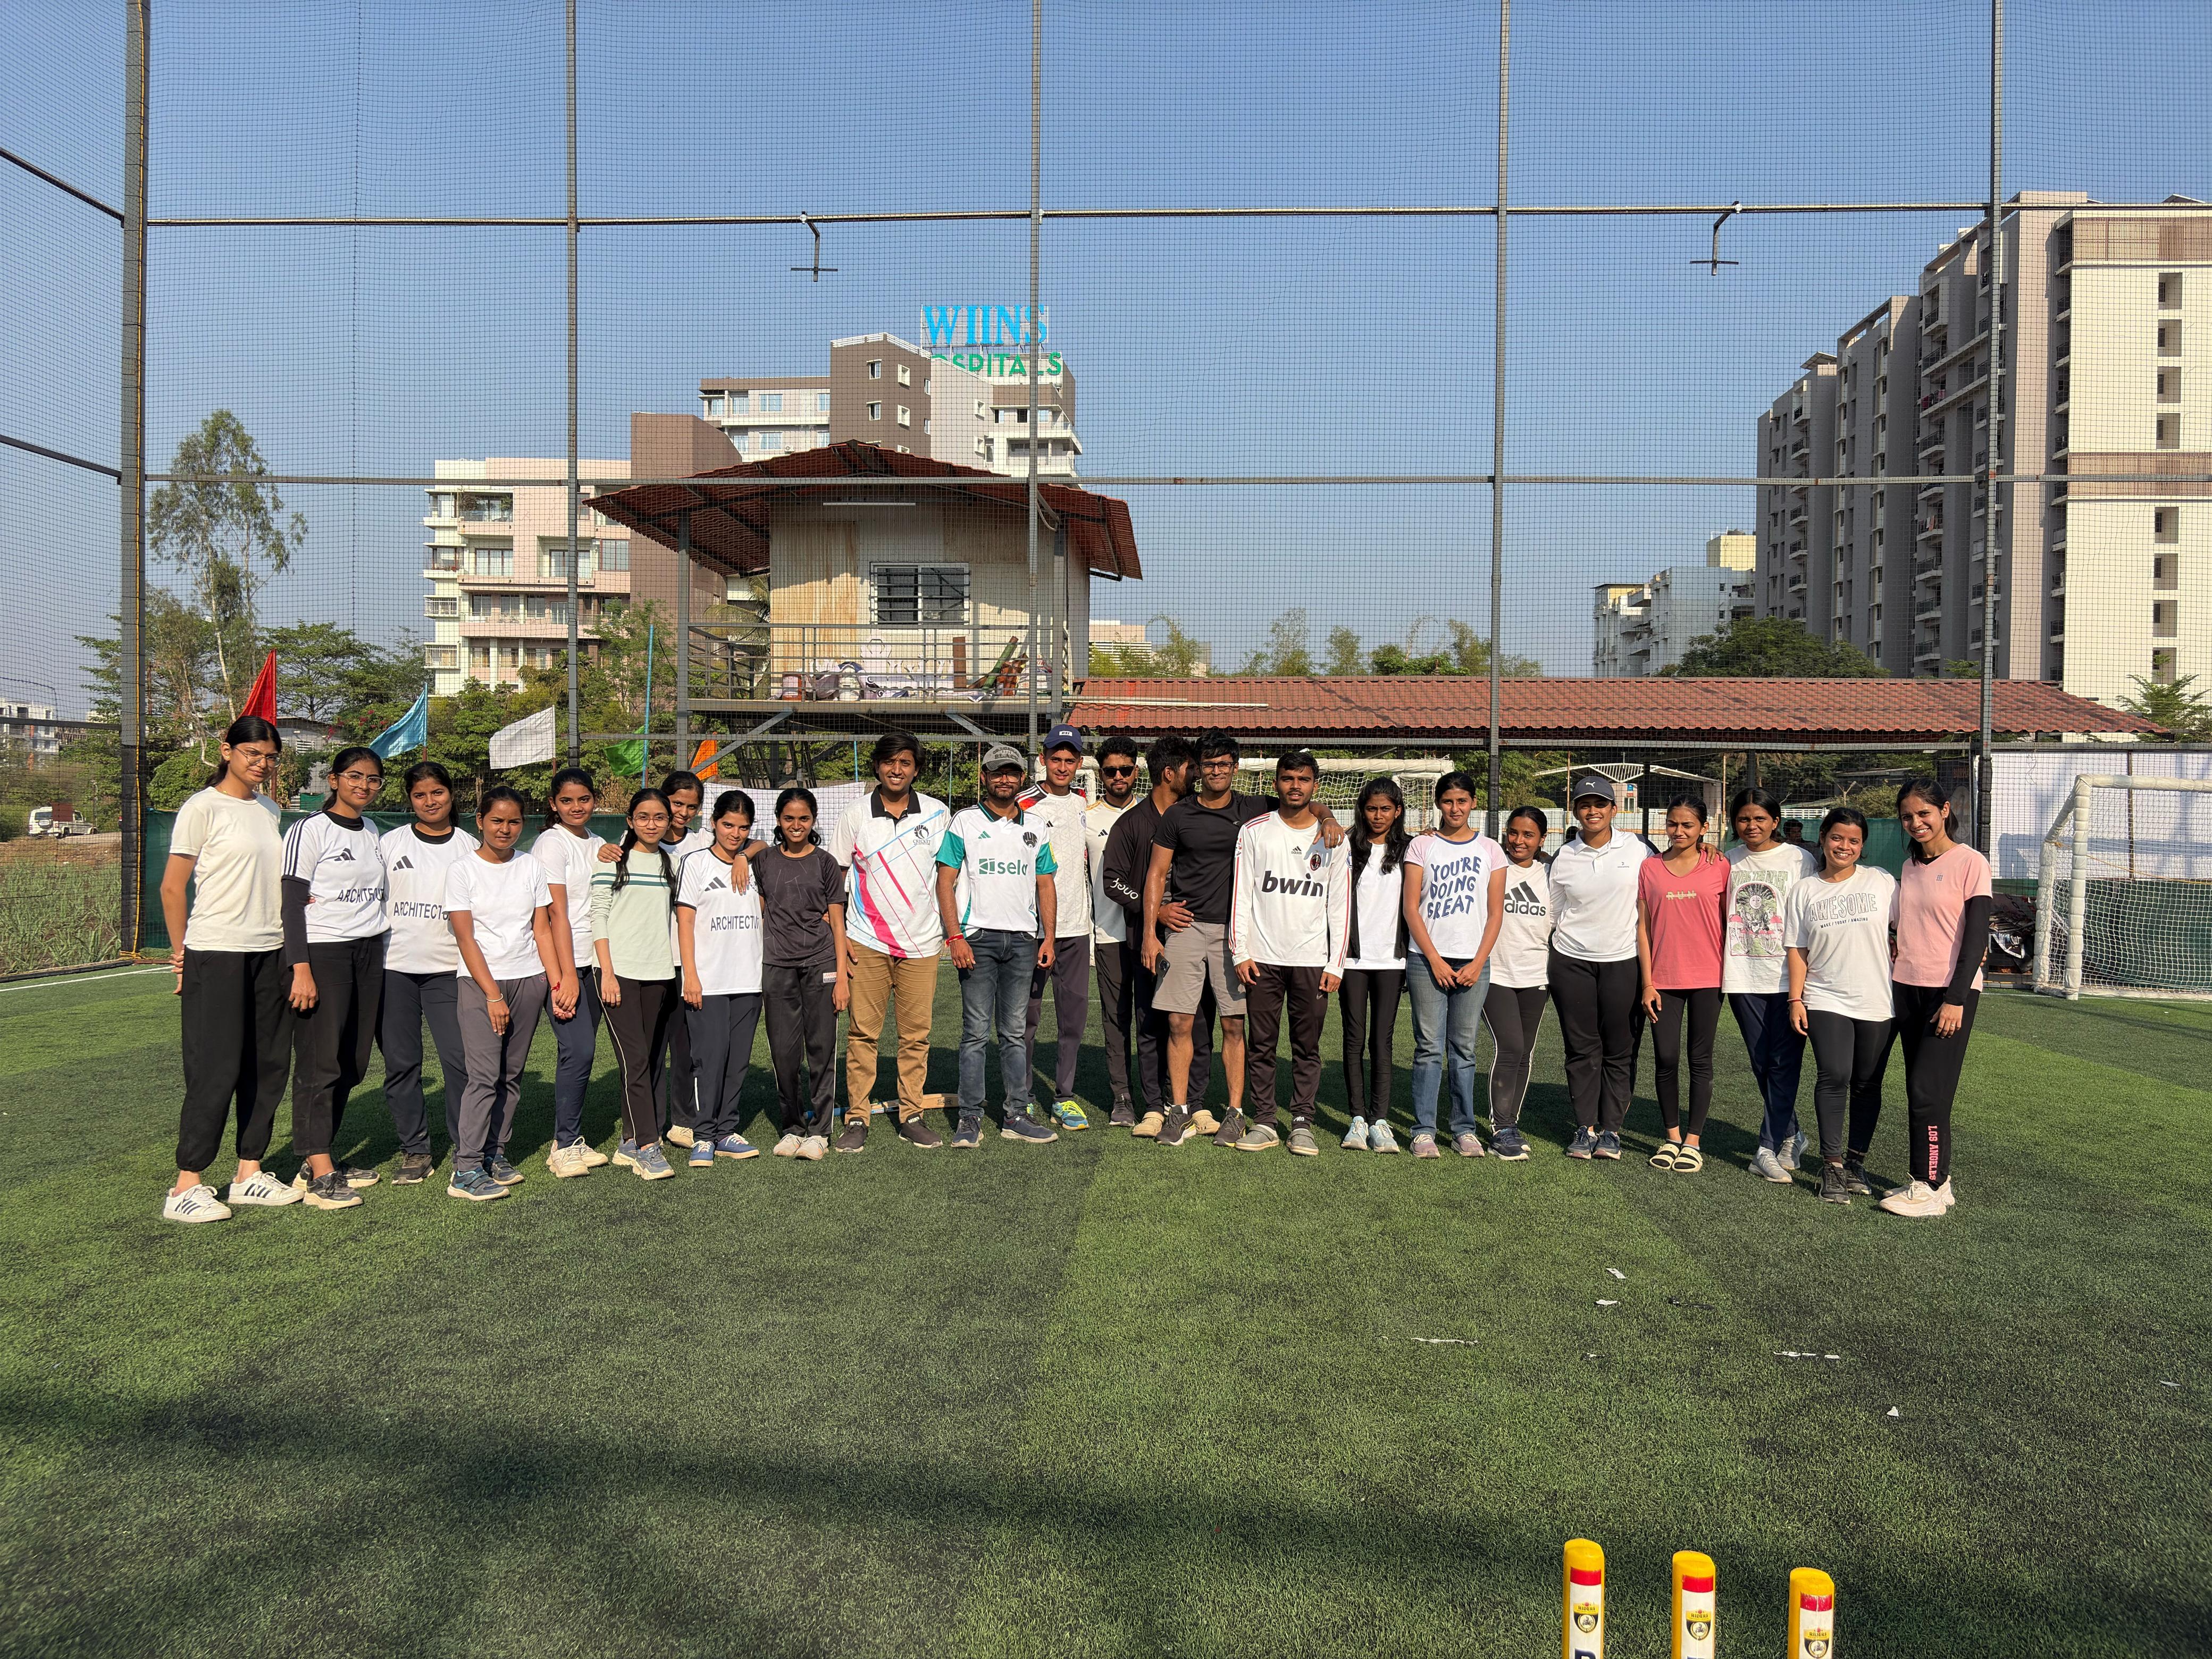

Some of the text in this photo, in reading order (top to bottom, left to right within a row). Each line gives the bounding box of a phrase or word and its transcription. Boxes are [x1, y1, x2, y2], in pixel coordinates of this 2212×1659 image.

[932, 351, 1061, 377] SPITAS
[1430, 856, 1481, 882] YOU'RE
[1261, 870, 1323, 897] bwin
[1430, 875, 1476, 900] DOING
[1427, 895, 1474, 920] GREAT
[1504, 900, 1546, 916] didas
[1809, 893, 1877, 921] AWESOME
[1928, 1125, 1939, 1180] LOS ANGELES
